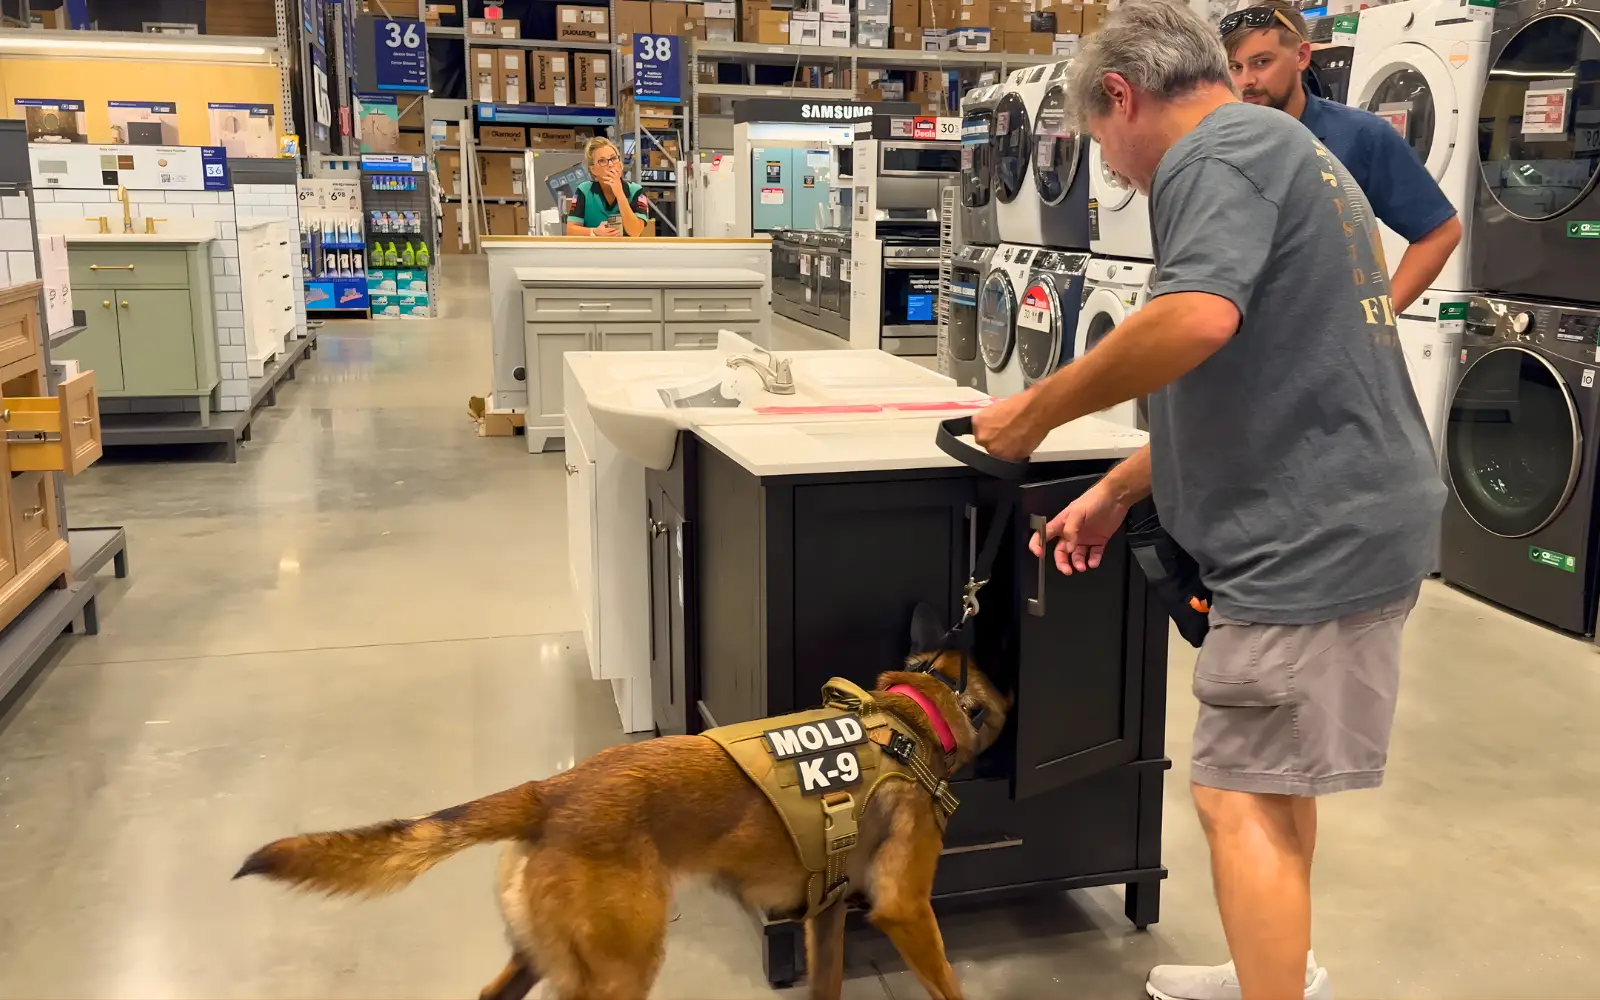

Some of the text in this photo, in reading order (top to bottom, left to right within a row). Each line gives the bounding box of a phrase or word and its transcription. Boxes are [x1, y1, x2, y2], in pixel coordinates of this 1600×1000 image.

[385, 22, 421, 49] 36
[562, 29, 596, 38] Diamond
[639, 36, 671, 62] 38
[538, 55, 546, 90] Diamond
[579, 57, 587, 91] Diamond
[801, 104, 873, 119] SAMSUNG
[491, 131, 521, 139] Diamond
[914, 129, 936, 138] Deals
[940, 123, 955, 133] 30
[542, 132, 572, 140] Diamond
[207, 166, 222, 175] 36
[767, 717, 864, 757] MOLD
[798, 752, 860, 791] K-9
